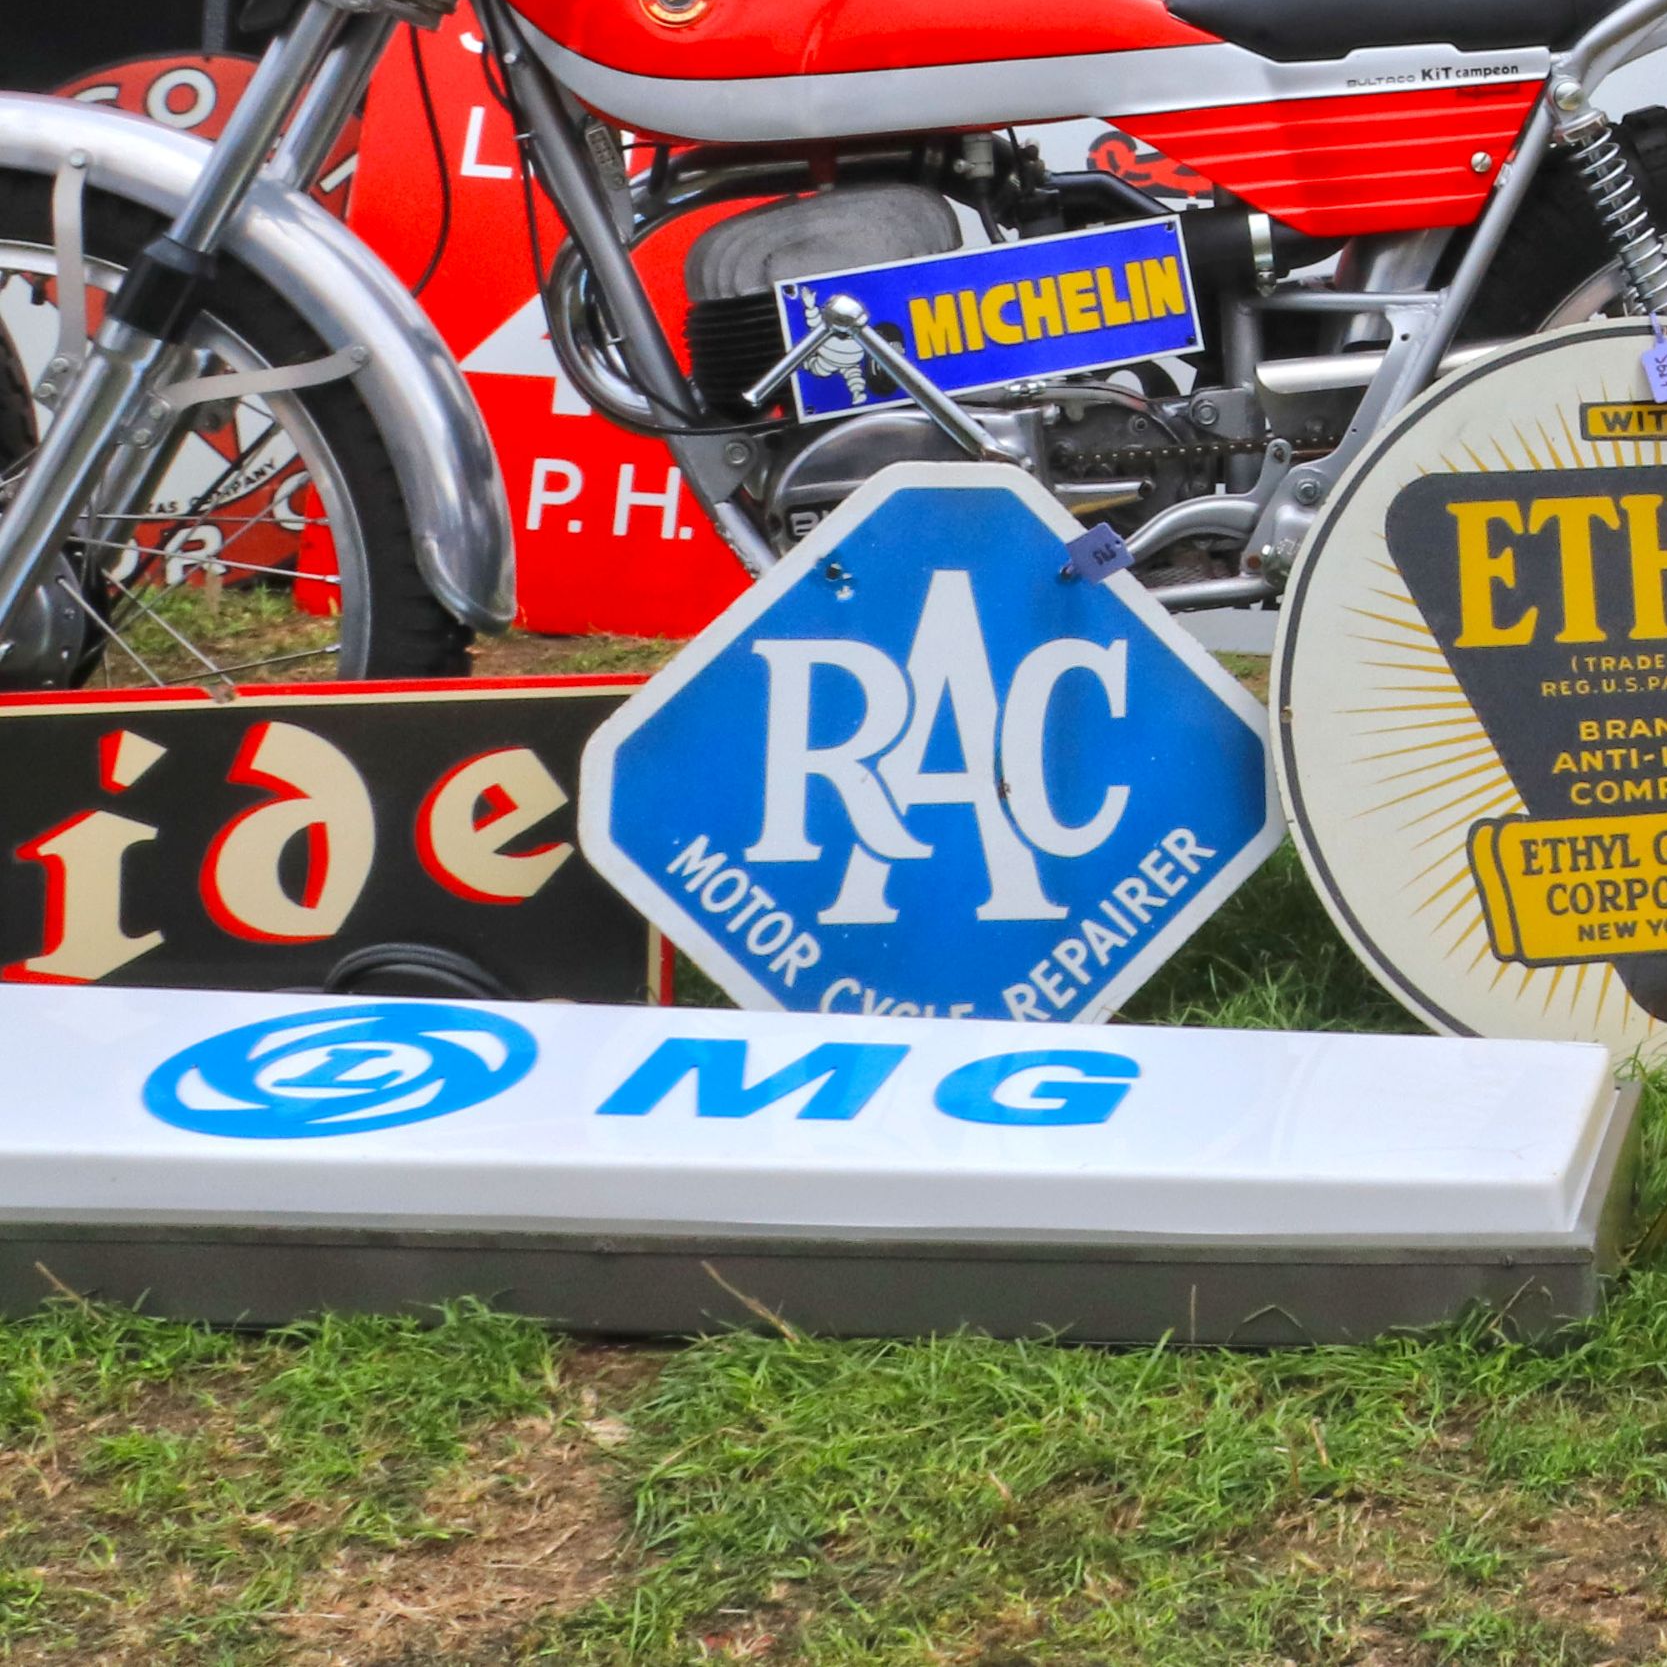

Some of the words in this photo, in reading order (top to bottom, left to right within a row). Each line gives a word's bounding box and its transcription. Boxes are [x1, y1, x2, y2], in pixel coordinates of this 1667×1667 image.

[1455, 64, 1519, 79] campeon
[909, 254, 1186, 361] MICHELIN
[1571, 653, 1666, 674] (TRADE
[745, 568, 1130, 926] RAC
[1521, 832, 1643, 876] ETHYL
[665, 834, 822, 988] MOTOR
[1002, 827, 1217, 1023] REPAIRER
[1577, 918, 1639, 943] NEW
[598, 1037, 1144, 1126] MG
